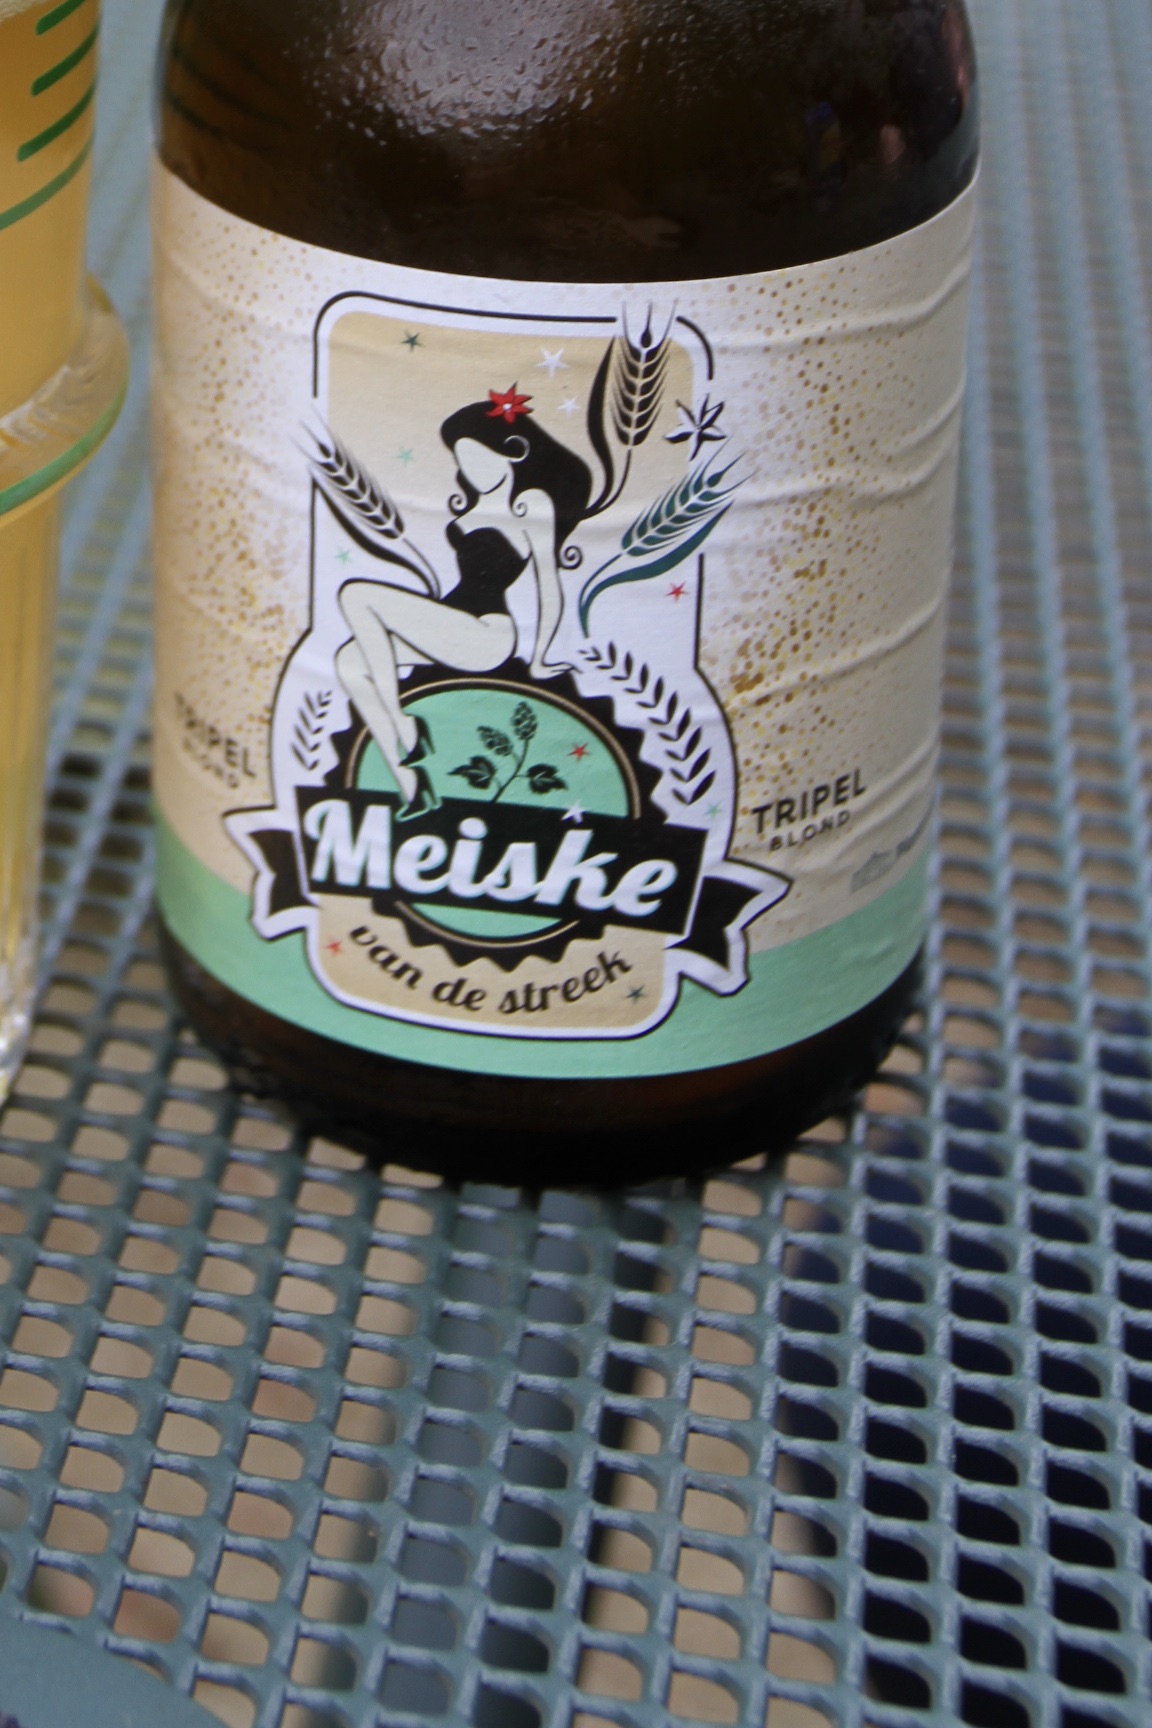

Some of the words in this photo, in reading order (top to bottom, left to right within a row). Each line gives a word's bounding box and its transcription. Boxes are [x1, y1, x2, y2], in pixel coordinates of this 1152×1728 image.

[751, 769, 868, 834] TRIPEL
[769, 810, 851, 852] BLOND
[303, 799, 679, 917] Meiske
[349, 925, 421, 991] van
[432, 978, 488, 1012] de
[497, 950, 633, 1014] streek
